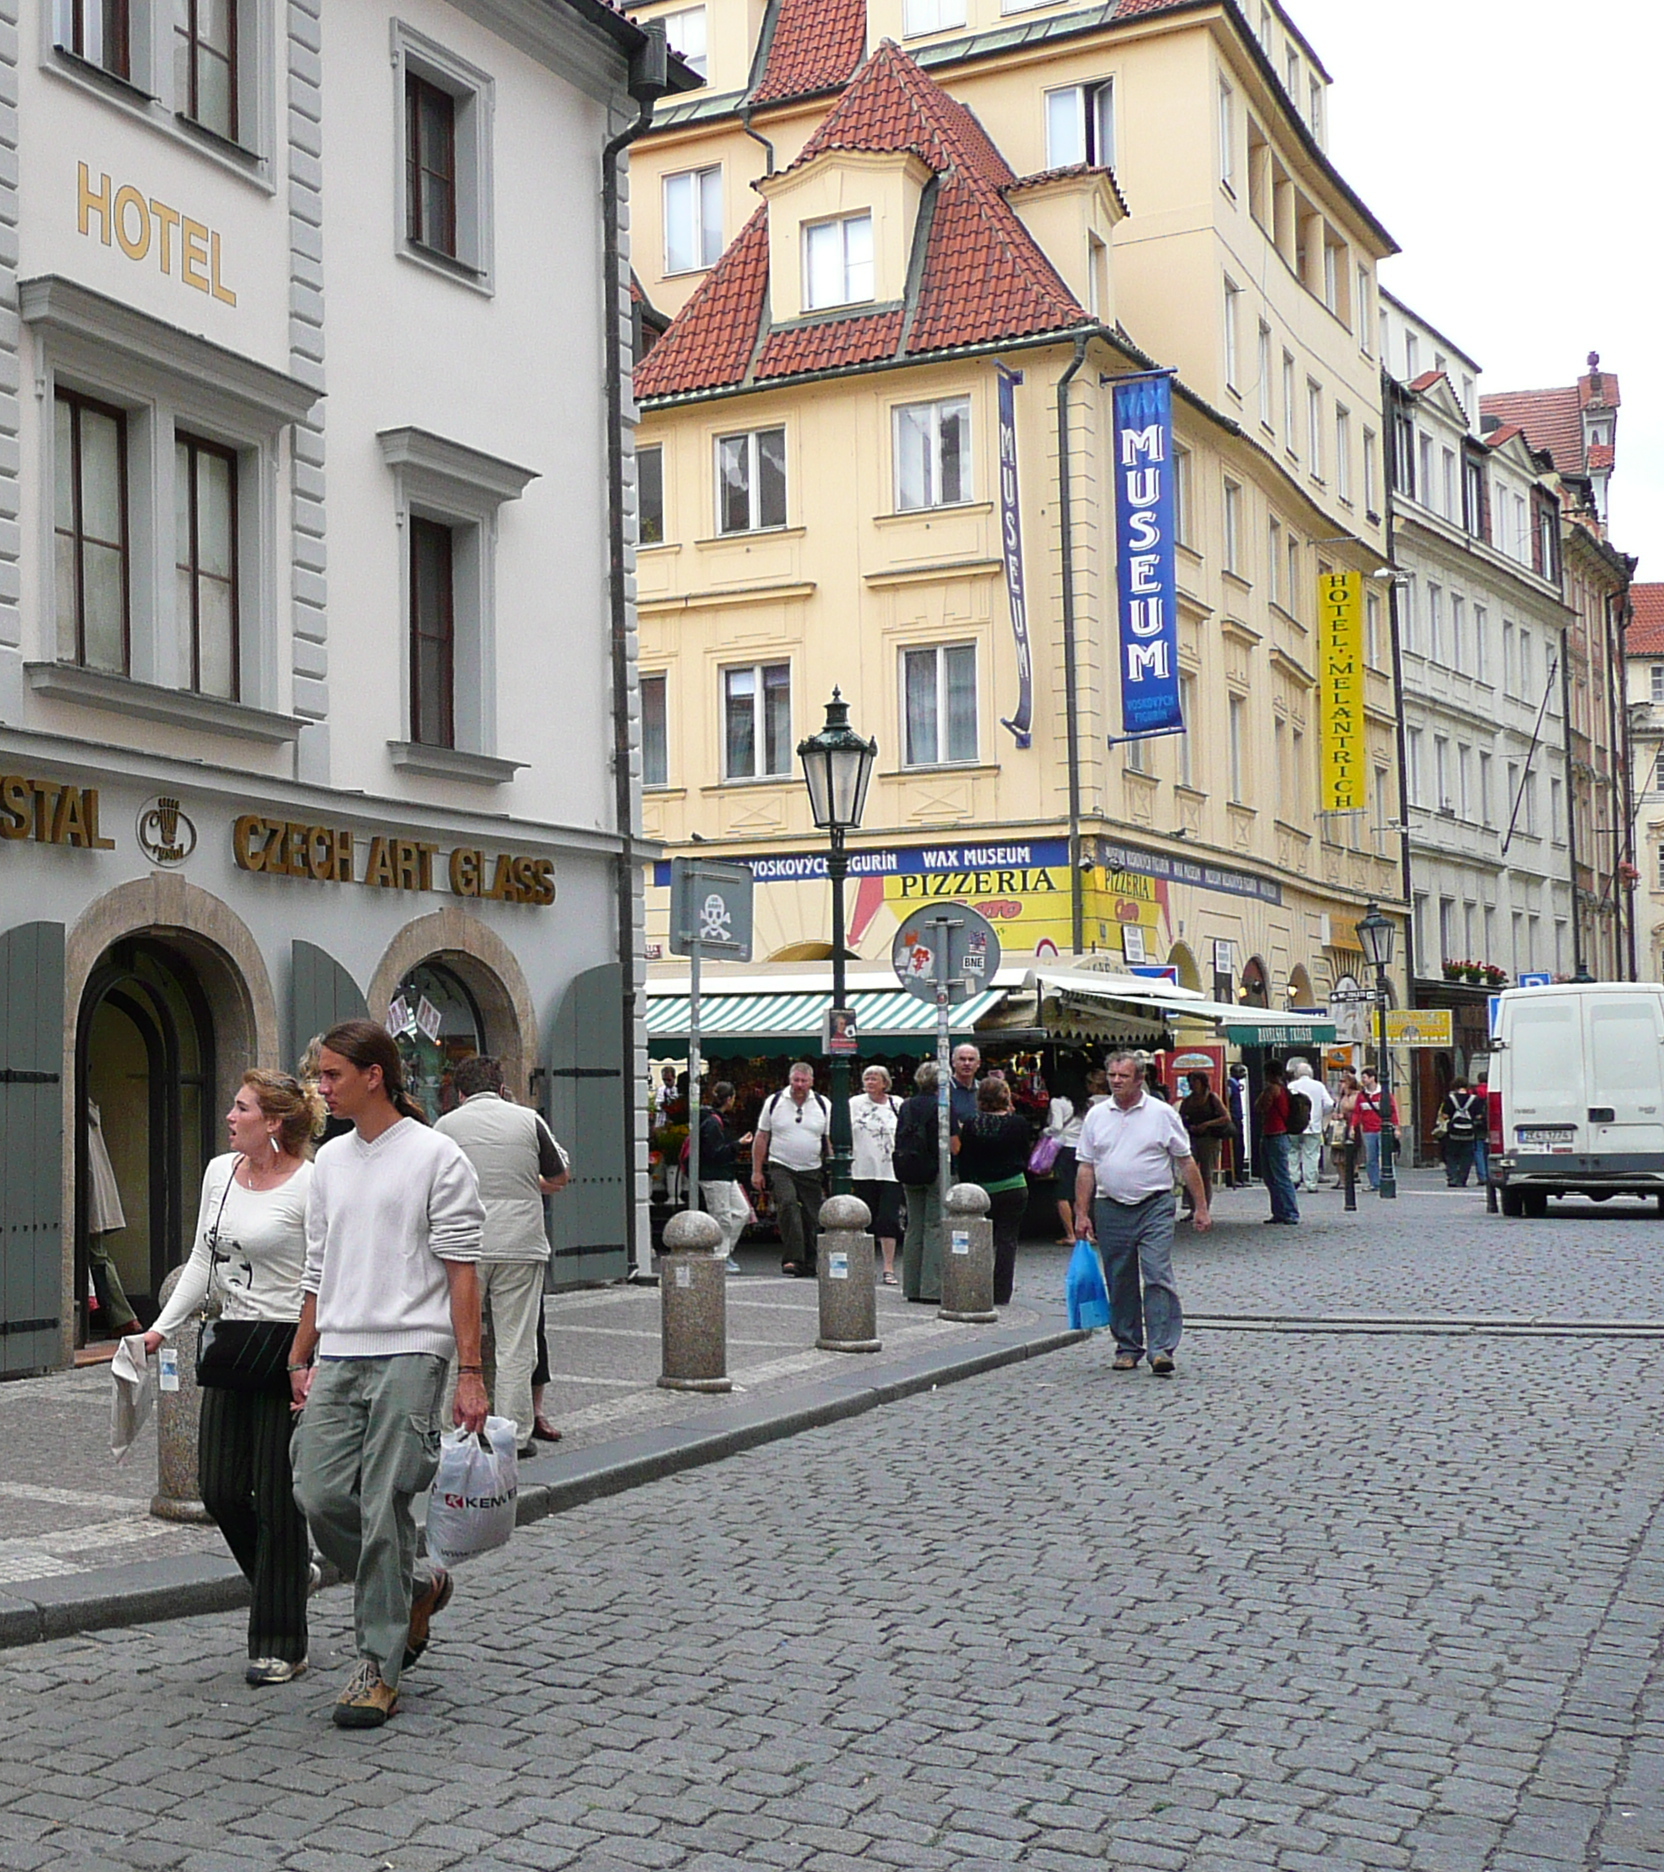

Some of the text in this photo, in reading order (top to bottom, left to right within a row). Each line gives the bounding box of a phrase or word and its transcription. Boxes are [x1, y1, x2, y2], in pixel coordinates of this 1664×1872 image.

[78, 160, 236, 307] HOTEL
[1001, 421, 1030, 680] MUSEUM
[1121, 423, 1170, 682] MUSEUM
[1328, 575, 1354, 807] HOTEL MELANTRICH
[234, 814, 556, 906] CZECH ART GLASS
[900, 867, 1057, 897] PIZZERIA
[922, 850, 960, 869] WAX
[964, 846, 1031, 867] MUSEUM
[1105, 868, 1149, 899] PIZZERIA
[964, 957, 983, 968] BNE
